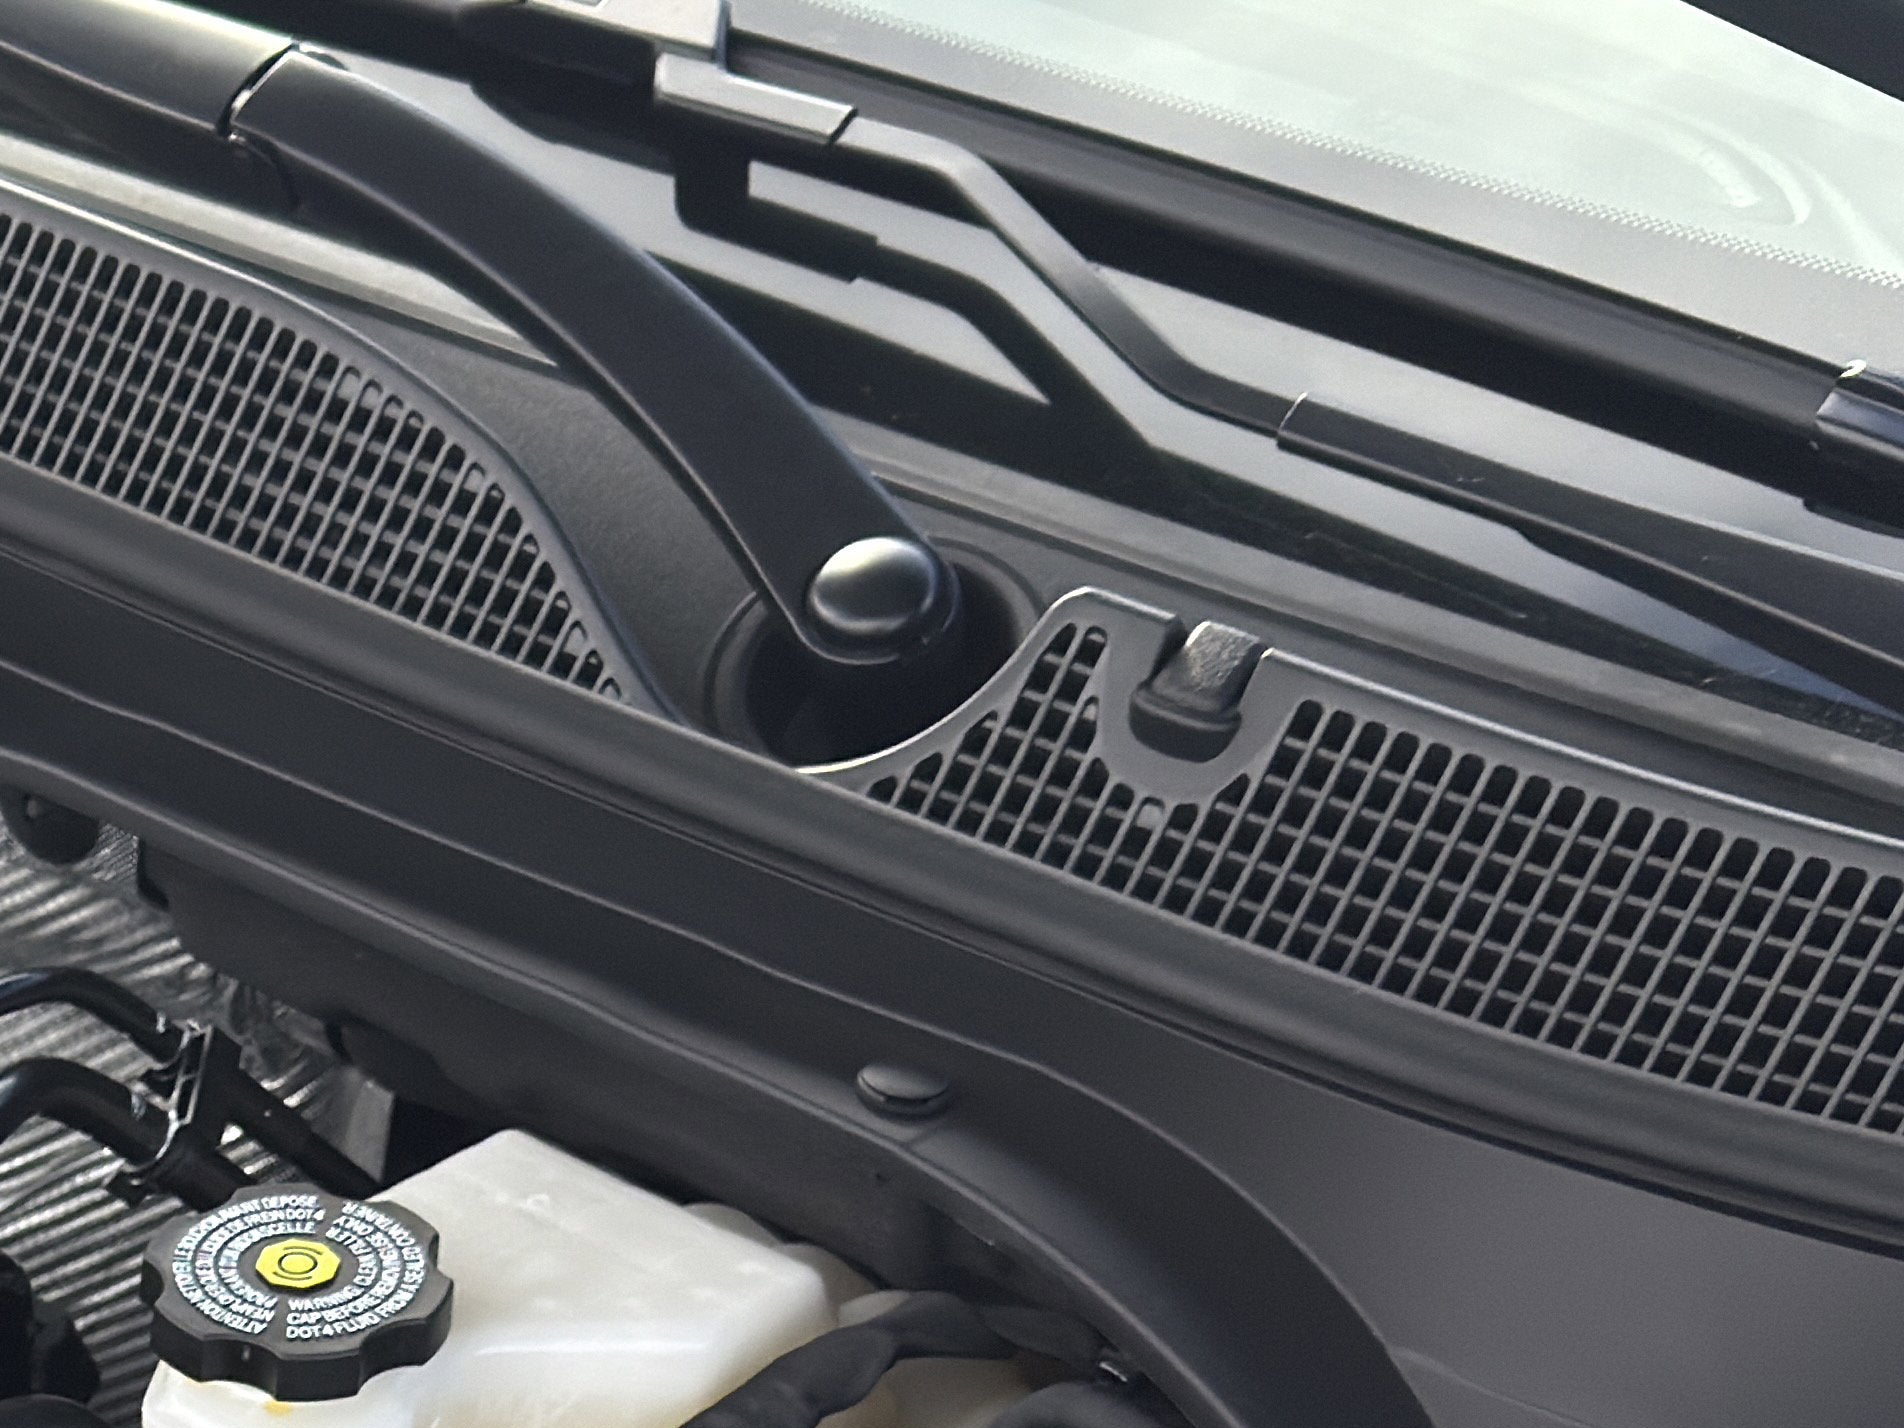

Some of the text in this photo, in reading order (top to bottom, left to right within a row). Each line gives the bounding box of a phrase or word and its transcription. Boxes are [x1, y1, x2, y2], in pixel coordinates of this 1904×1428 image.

[285, 1208, 314, 1219] DOT
[313, 1209, 326, 1220] 4
[285, 1311, 325, 1324] CAP
[320, 1294, 386, 1323] BEFORE
[285, 1325, 324, 1338] DOT
[320, 1324, 337, 1338] 4
[332, 1312, 387, 1336] FLUID
